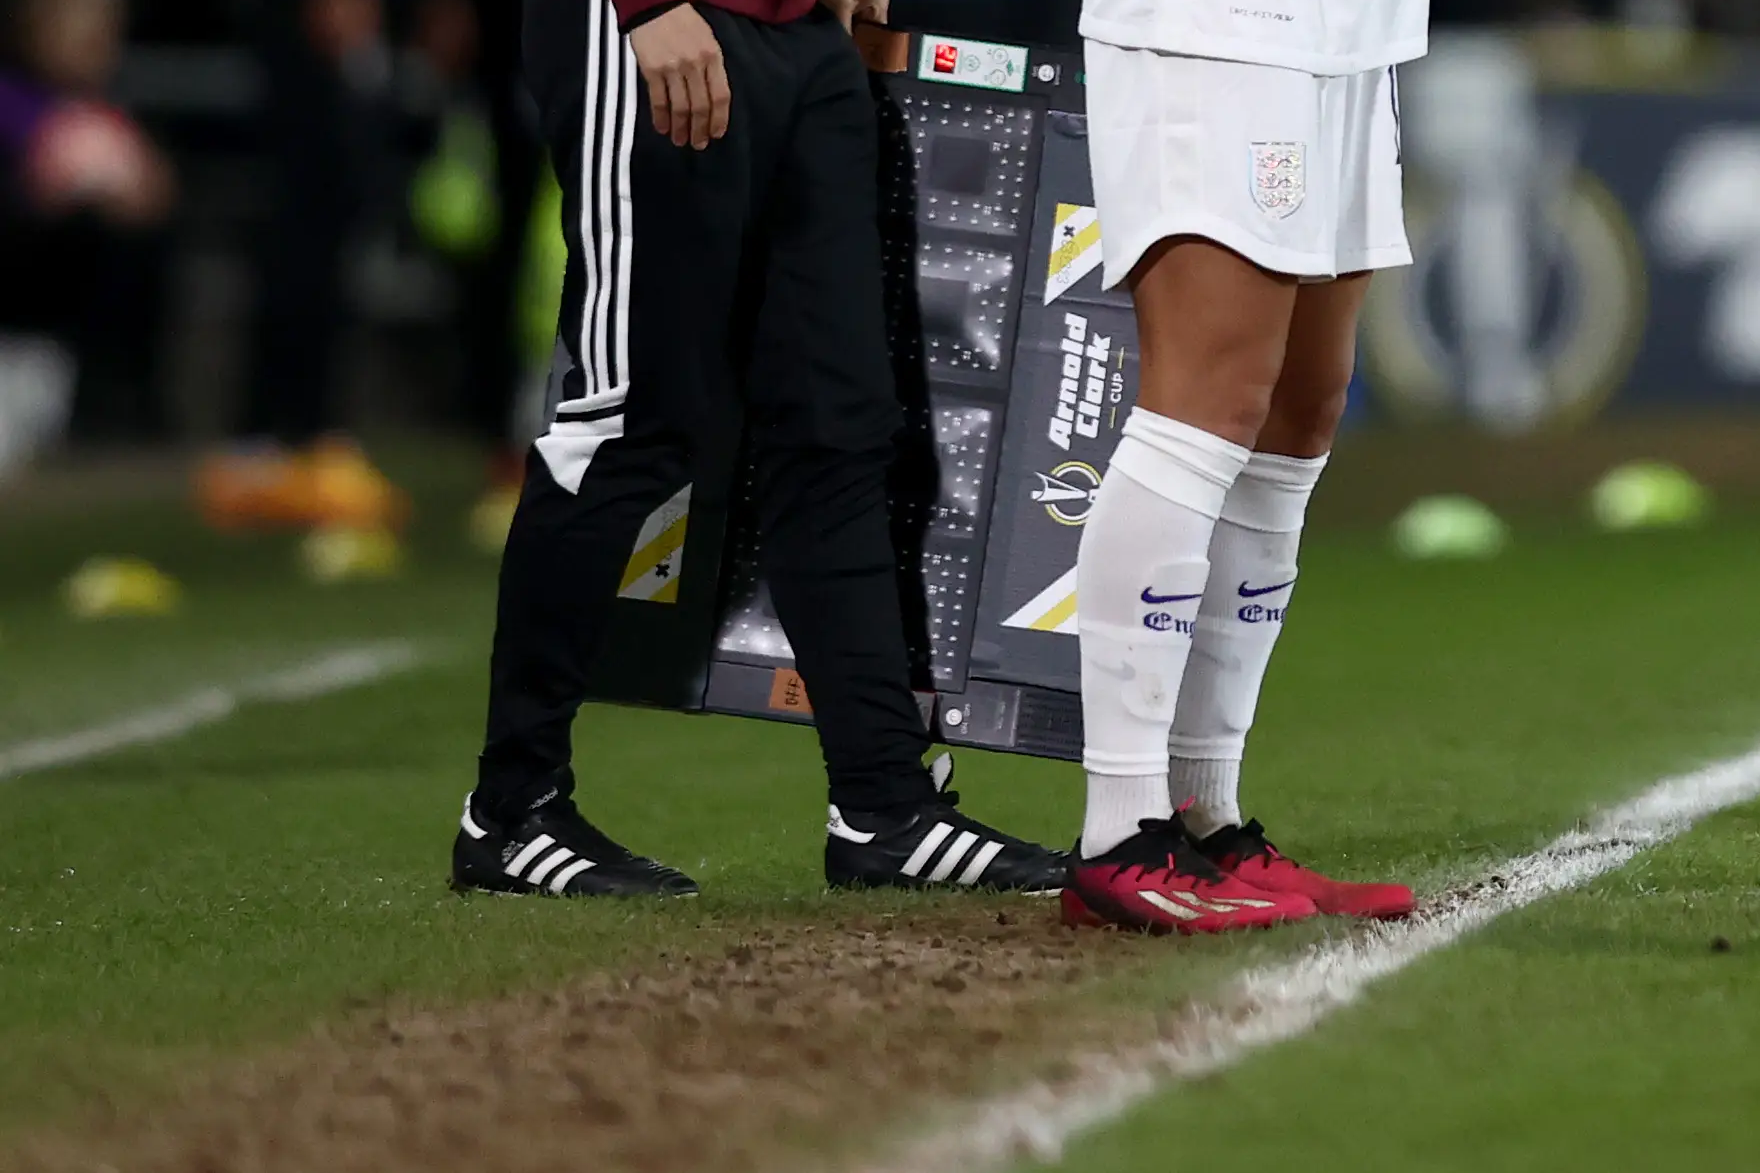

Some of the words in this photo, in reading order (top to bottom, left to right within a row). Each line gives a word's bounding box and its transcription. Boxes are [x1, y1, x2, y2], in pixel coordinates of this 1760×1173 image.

[1048, 312, 1088, 451] Arnold
[1075, 332, 1112, 439] Clark
[1110, 372, 1124, 404] CUP
